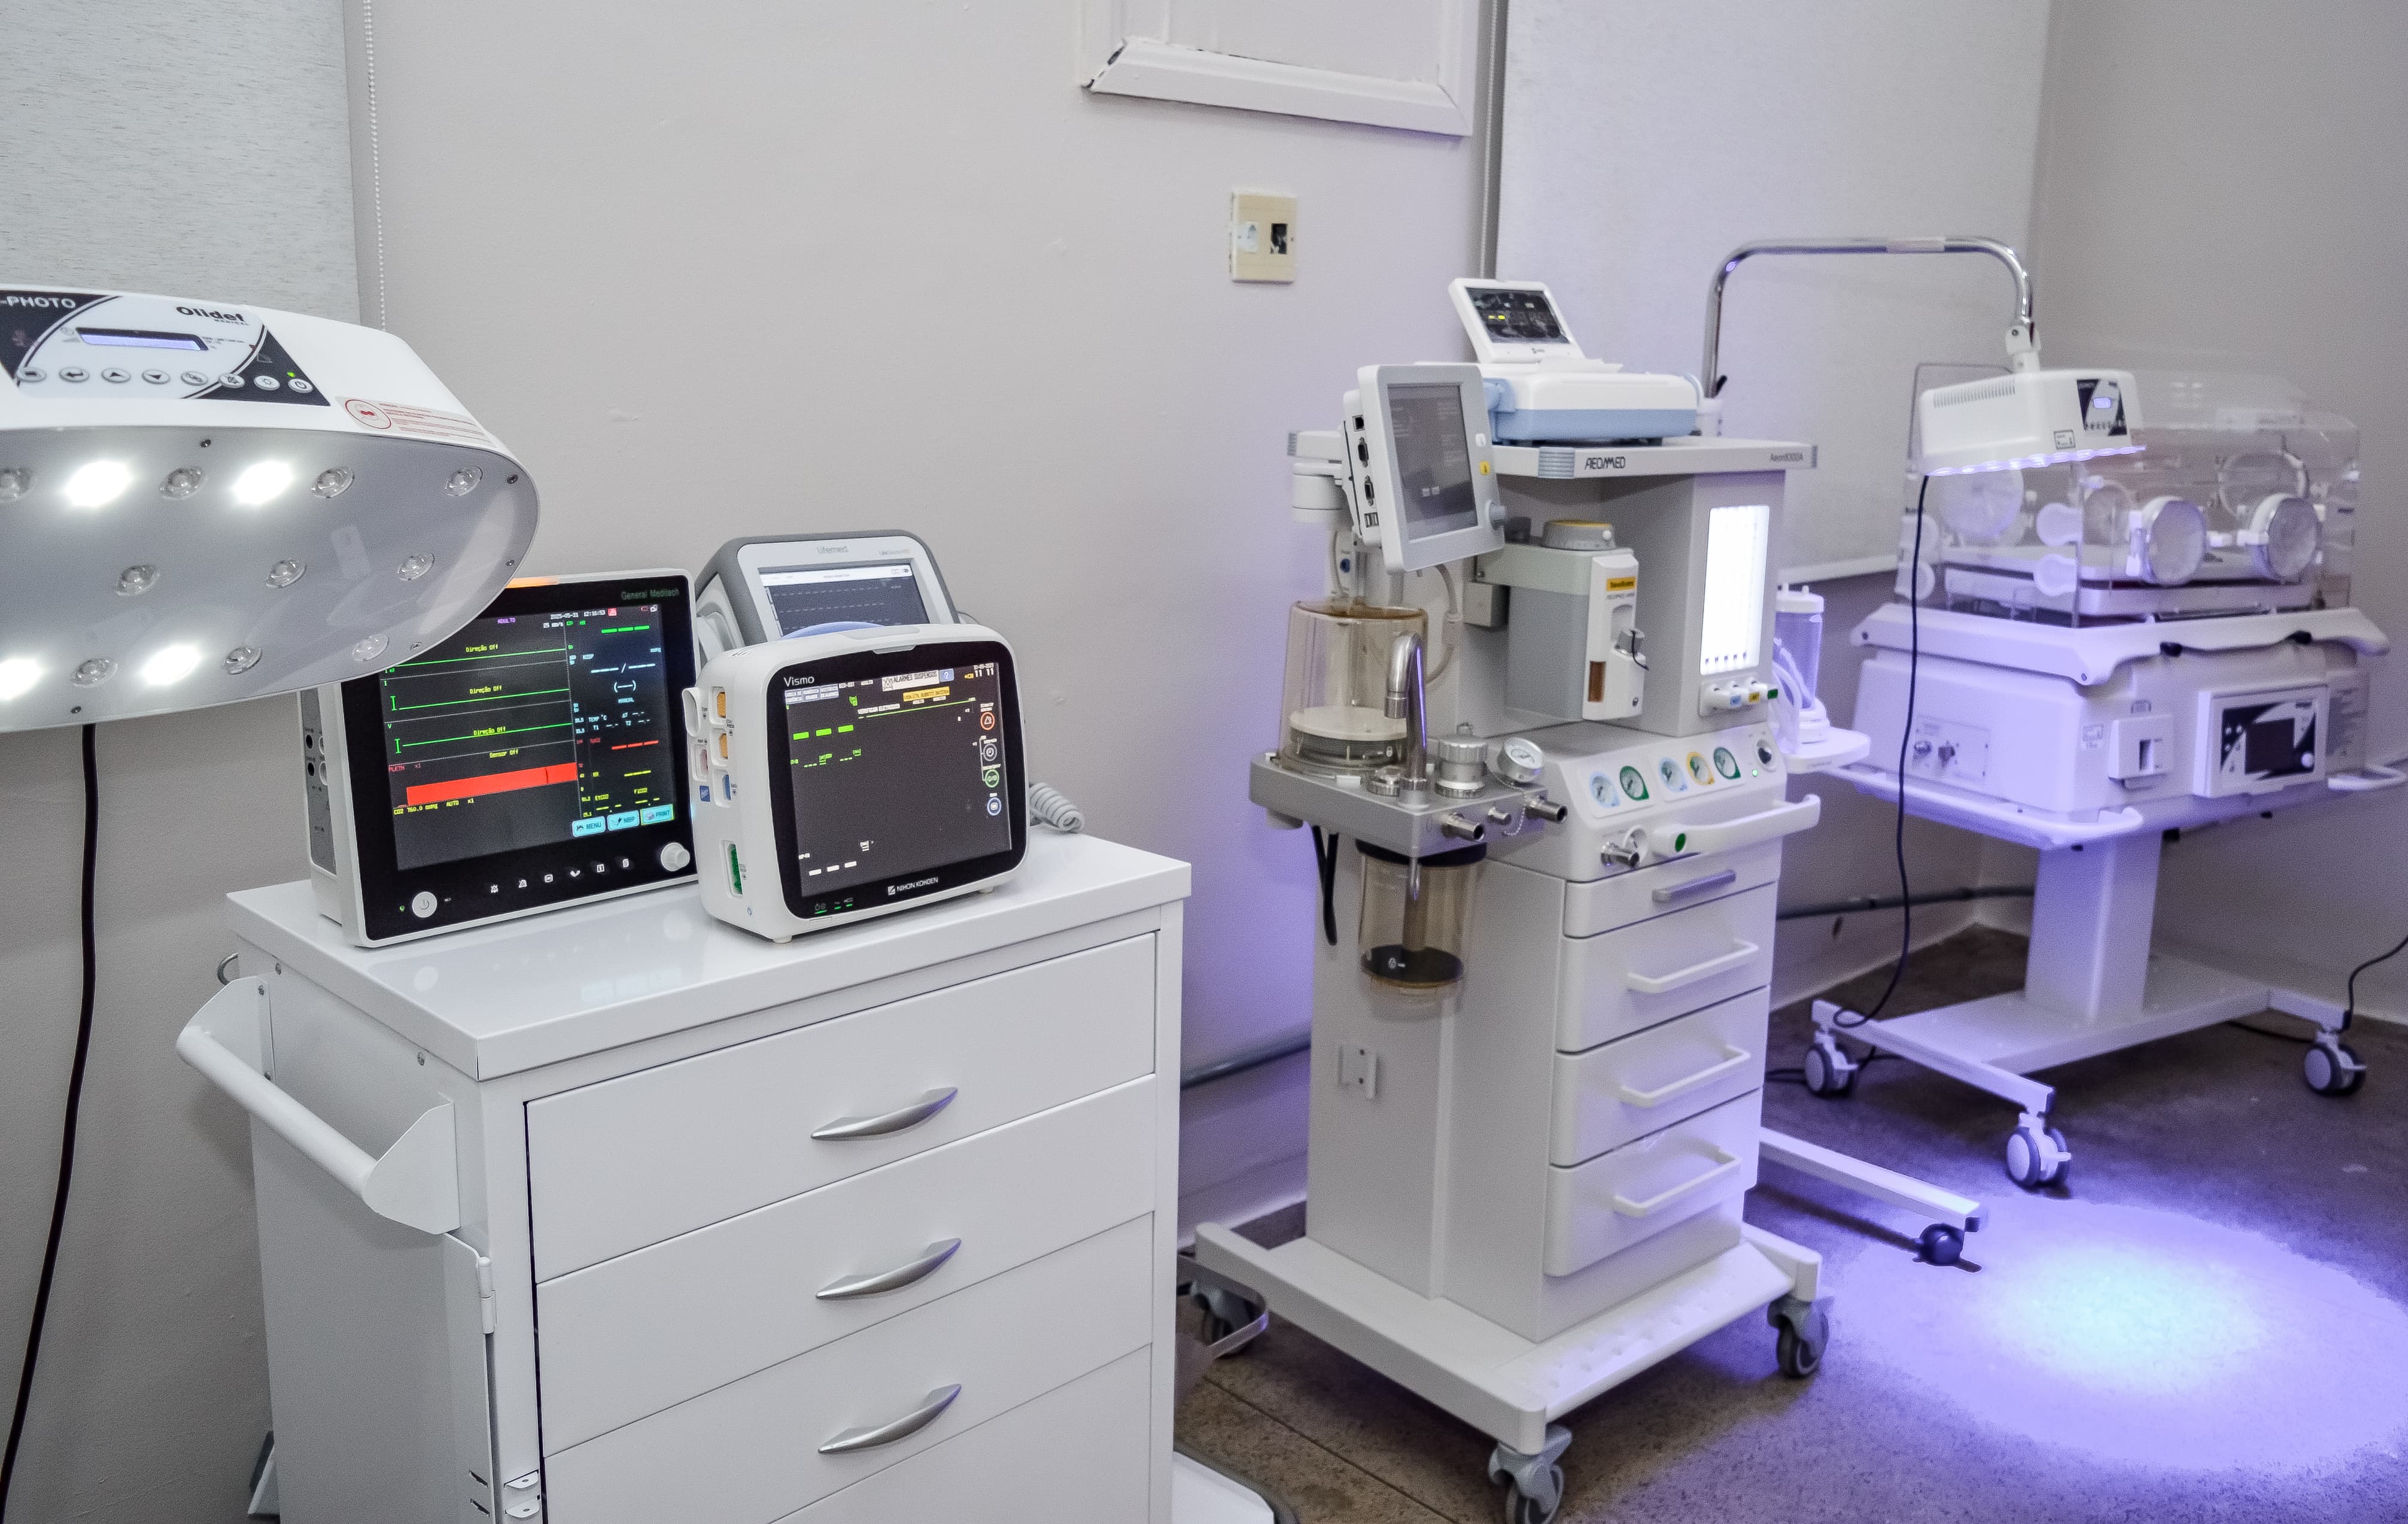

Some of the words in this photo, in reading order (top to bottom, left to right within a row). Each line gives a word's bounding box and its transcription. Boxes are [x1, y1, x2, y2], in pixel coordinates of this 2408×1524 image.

[621, 590, 647, 600] General
[784, 676, 814, 687] Vismo
[897, 883, 916, 891] NIHON
